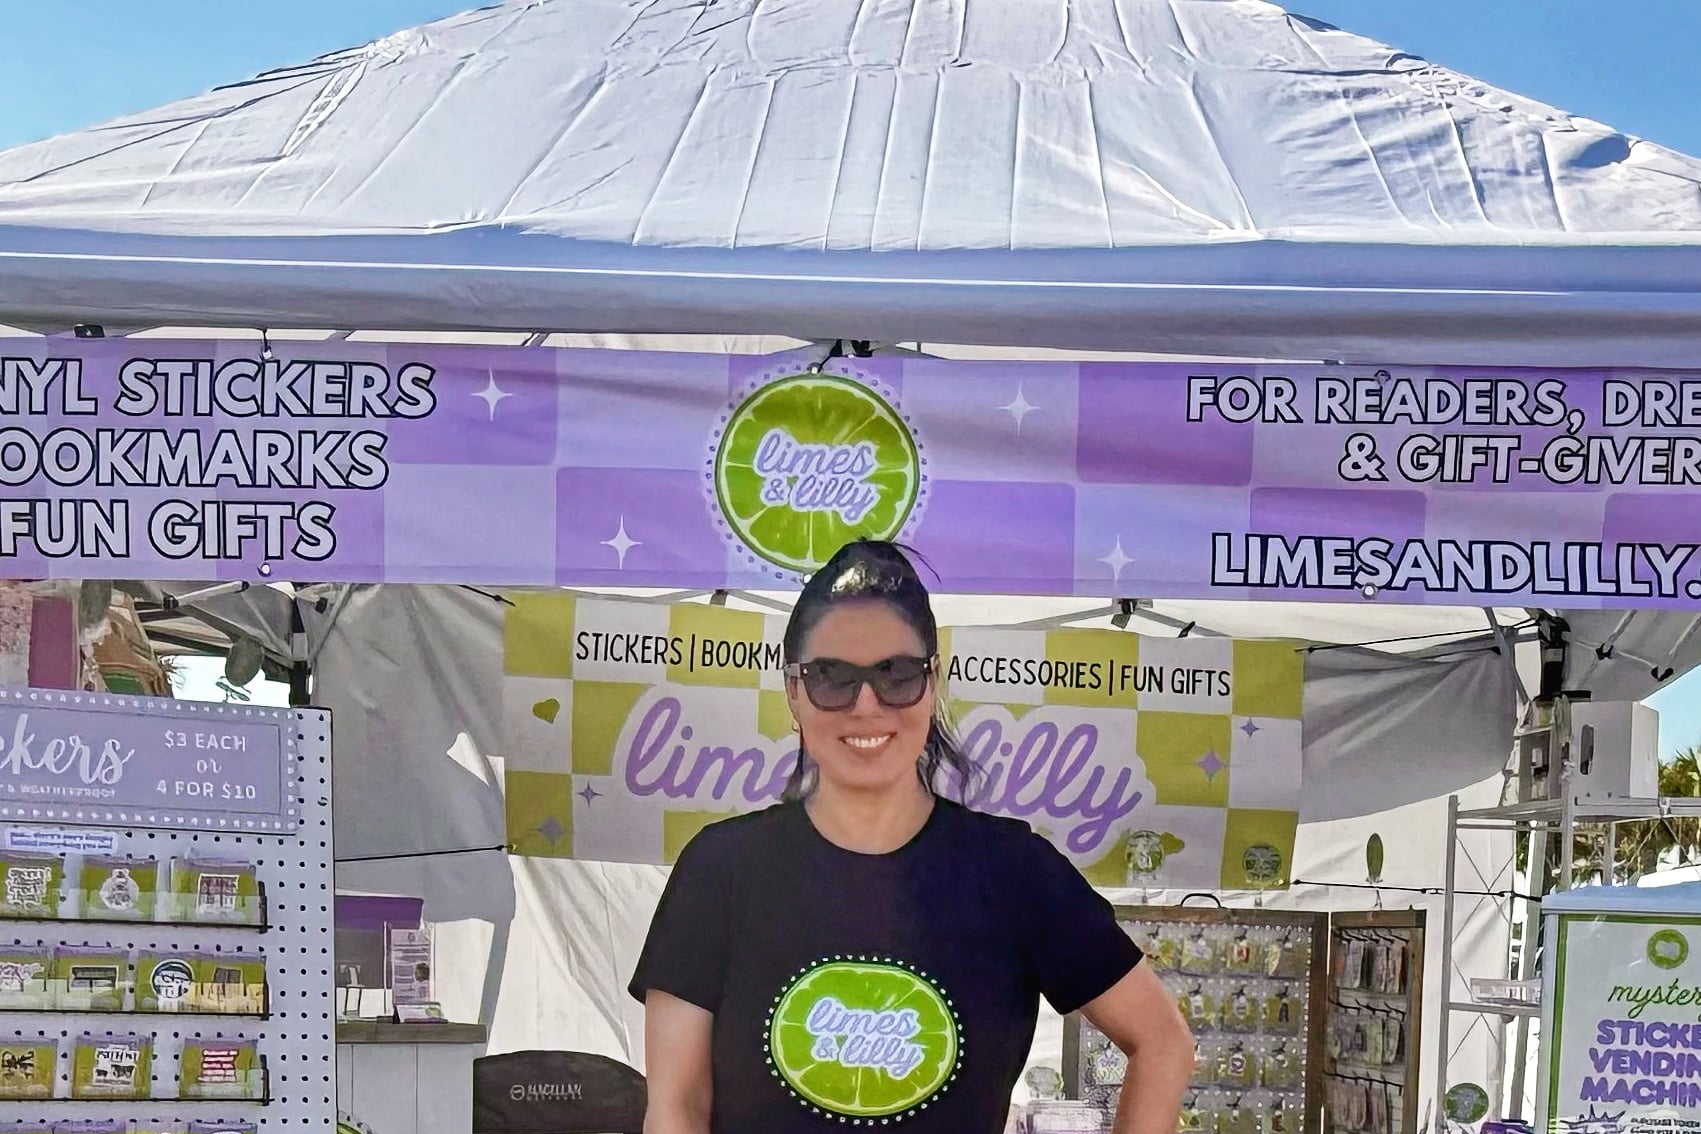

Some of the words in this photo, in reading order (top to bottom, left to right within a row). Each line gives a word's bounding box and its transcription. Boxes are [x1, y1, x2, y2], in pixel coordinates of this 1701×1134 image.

[114, 357, 437, 419] STICKERS
[1186, 376, 1303, 423] FOR
[1315, 377, 1584, 434] READERS,
[757, 432, 875, 475] limes
[1337, 432, 1388, 482] &
[1396, 434, 1701, 485] GIFT-GIVER
[764, 477, 785, 503] &
[795, 474, 879, 522] lilly
[0, 499, 129, 559] FUN
[148, 500, 337, 560] GIFTS
[576, 631, 683, 666] STICKERS
[701, 639, 785, 671] BOOKM
[948, 656, 1102, 690] ACCESSORIES
[1120, 664, 1164, 694] FUN
[1171, 668, 1231, 697] GIFTS
[165, 730, 187, 749] $3
[196, 732, 248, 752] EACH
[155, 779, 167, 795] 4
[175, 780, 214, 797] FOR
[222, 783, 257, 800] $10
[810, 998, 920, 1038] limes
[1607, 978, 1701, 1022] myster
[814, 1036, 835, 1059] &
[842, 1034, 924, 1078] lilly
